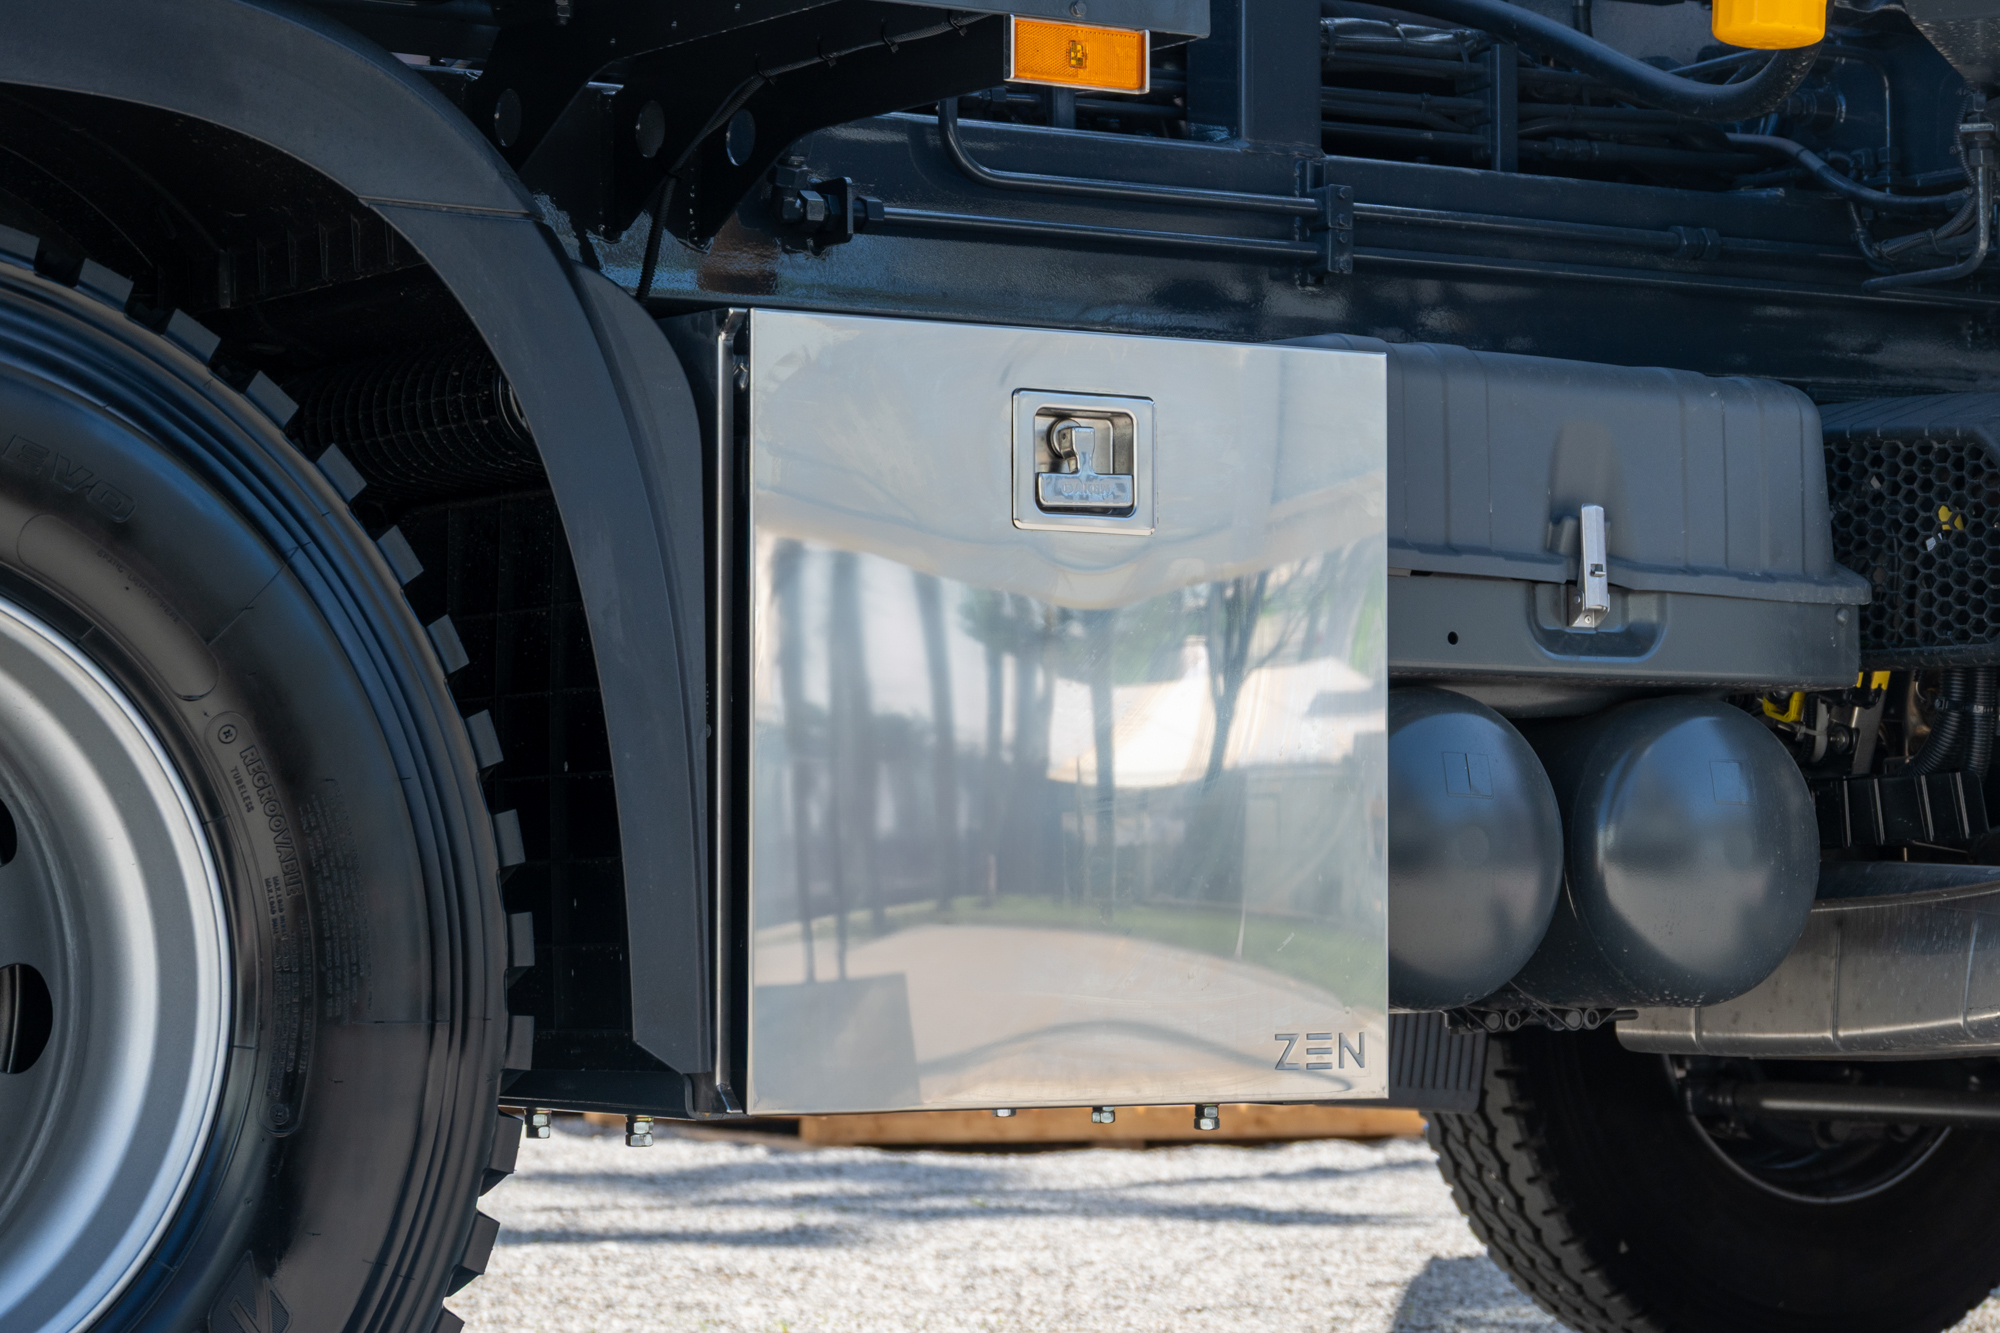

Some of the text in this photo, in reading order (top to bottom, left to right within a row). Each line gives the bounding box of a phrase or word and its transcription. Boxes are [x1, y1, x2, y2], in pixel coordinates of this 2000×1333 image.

[1, 434, 137, 523] EVO
[229, 766, 255, 813] TUBELESS
[240, 745, 304, 897] REGROOVABLE
[1274, 1031, 1365, 1070] ZEN
